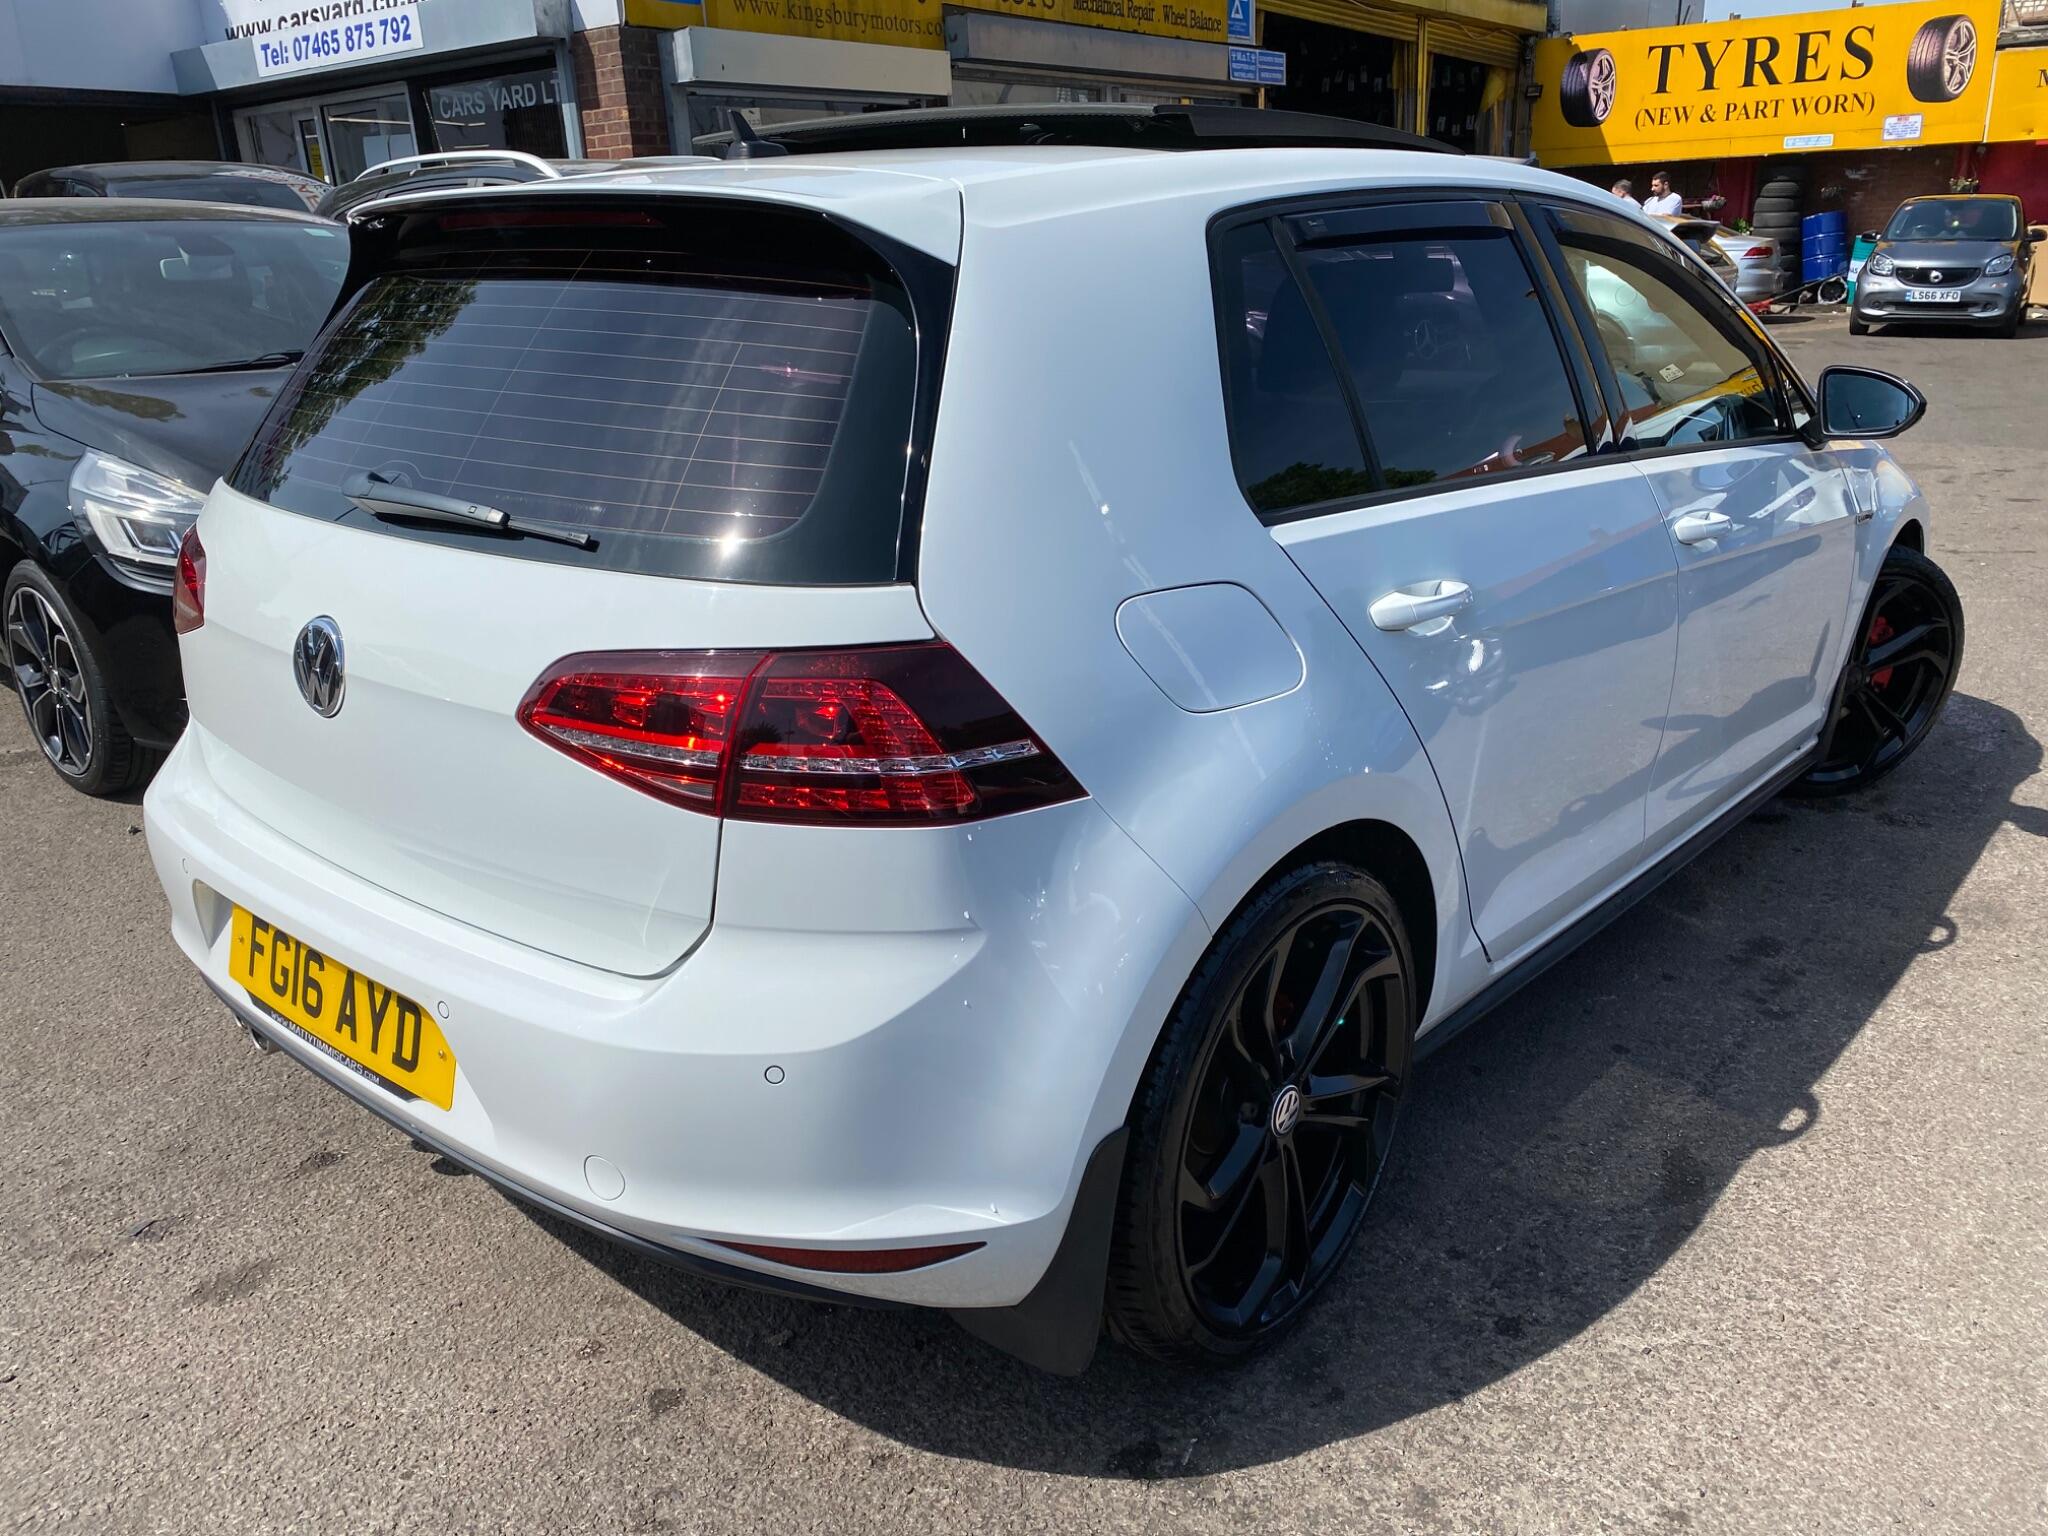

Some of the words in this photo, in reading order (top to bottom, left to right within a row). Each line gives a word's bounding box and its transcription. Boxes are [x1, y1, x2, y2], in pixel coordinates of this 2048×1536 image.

[1162, 4, 1188, 27] Wheel
[1190, 10, 1222, 32] Balance
[260, 41, 289, 67] Tel:
[293, 29, 340, 62] 07465
[345, 22, 375, 51] 875
[379, 14, 412, 45] 792
[1647, 25, 1877, 94] TYRES
[440, 91, 486, 119] CARS
[487, 82, 537, 112] YARD
[1635, 105, 1694, 132] (NEW
[1700, 104, 1716, 123] &
[1724, 98, 1785, 121] PART
[1792, 91, 1875, 117] WORN)
[1912, 291, 1937, 300] LS66
[249, 913, 325, 1019] FG16
[335, 968, 422, 1073] AYD
